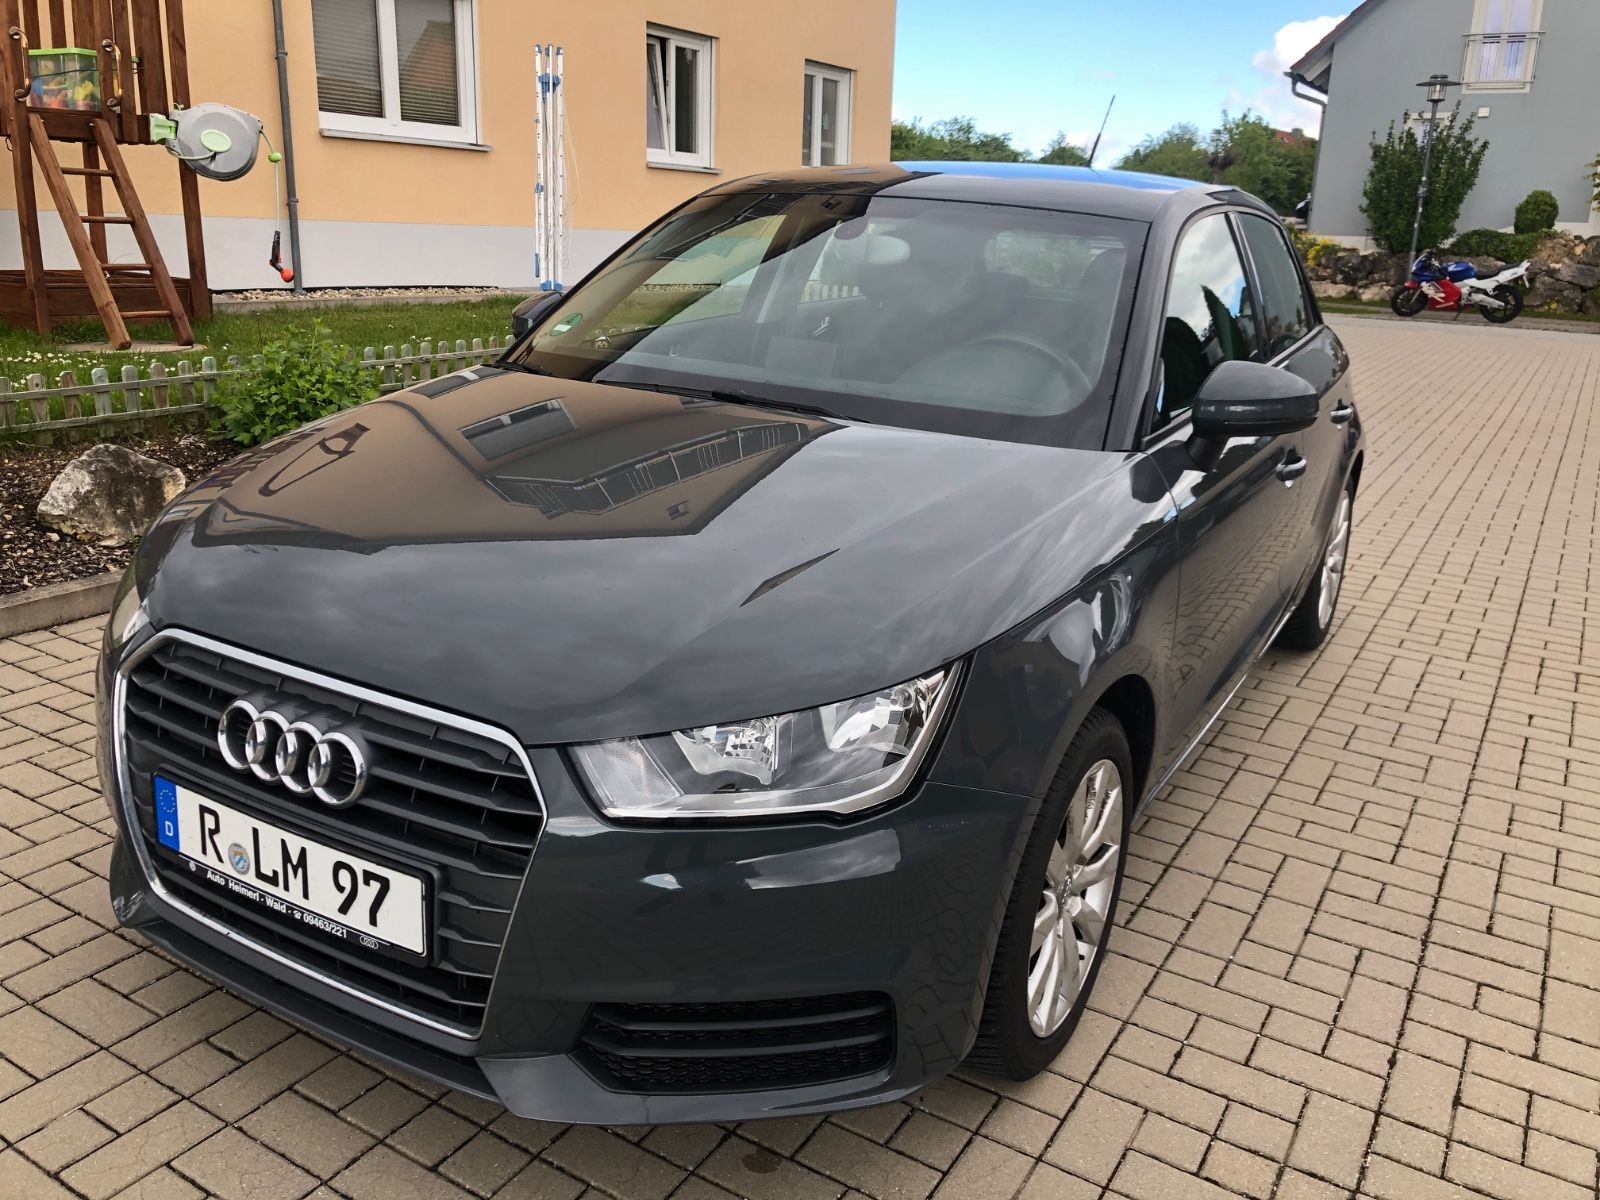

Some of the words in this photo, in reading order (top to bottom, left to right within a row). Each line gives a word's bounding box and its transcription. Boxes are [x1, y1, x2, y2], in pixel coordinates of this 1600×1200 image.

[165, 821, 174, 836] D
[199, 803, 224, 864] R
[252, 826, 309, 901] LM
[332, 860, 391, 928] 97
[206, 870, 226, 886] Auto
[265, 896, 287, 914] Wald
[303, 912, 347, 939] 09463/221
